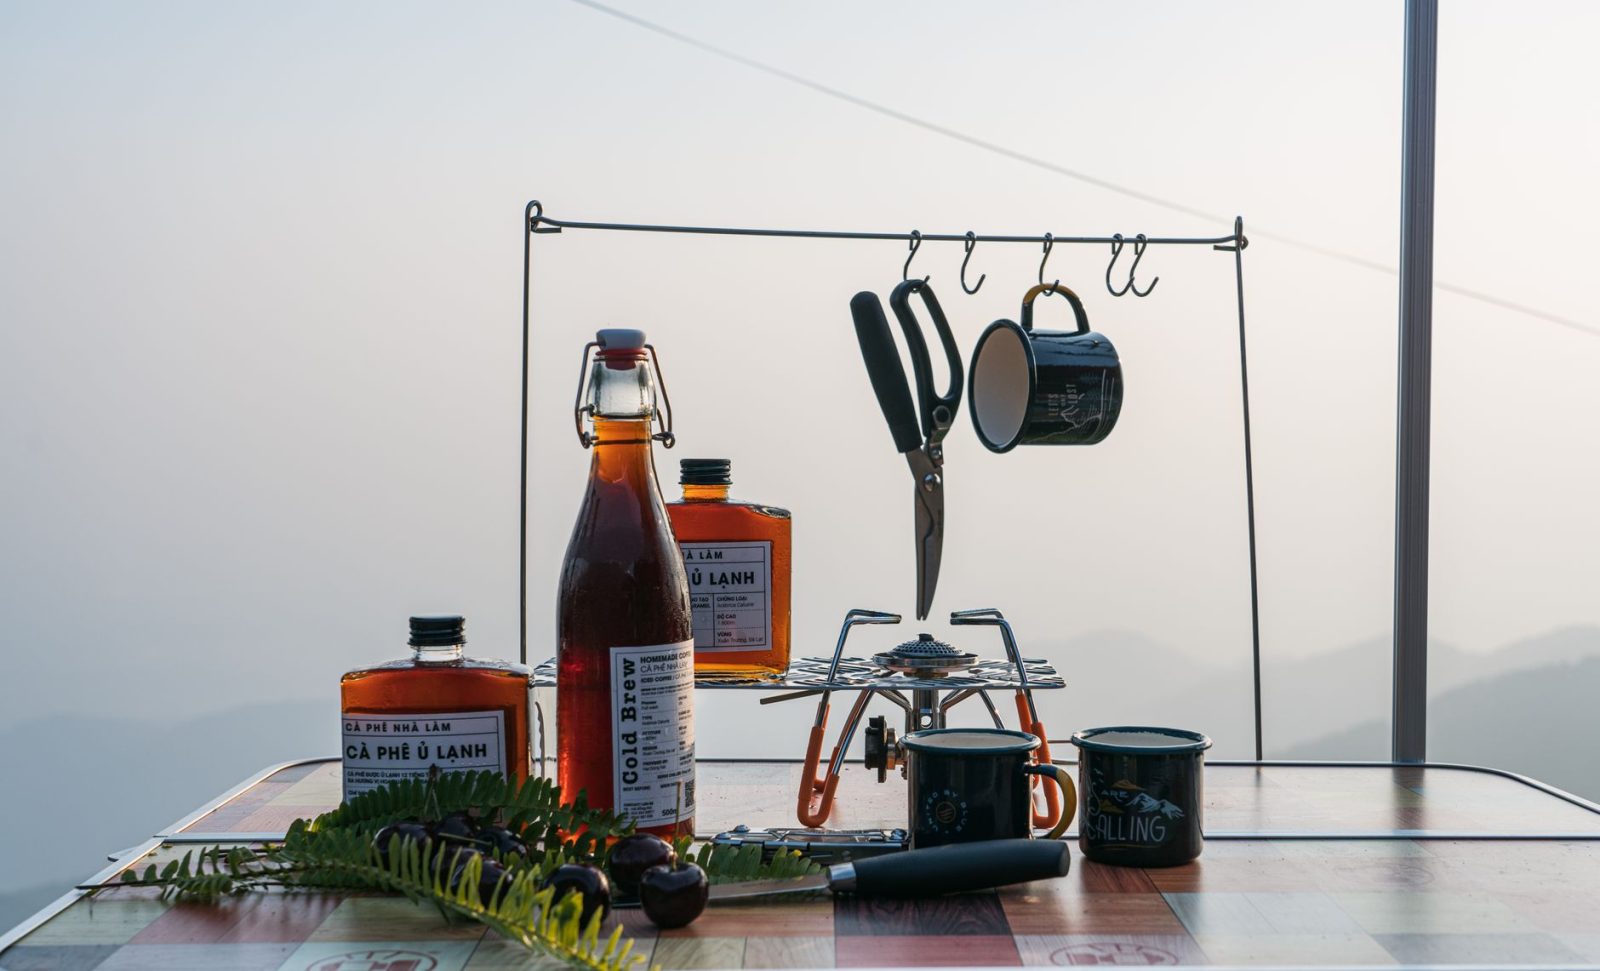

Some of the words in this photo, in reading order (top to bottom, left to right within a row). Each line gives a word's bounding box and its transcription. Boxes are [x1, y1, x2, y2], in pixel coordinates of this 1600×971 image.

[1066, 384, 1078, 404] LOST
[700, 550, 723, 560] LÀM
[691, 567, 702, 586] Ủ
[709, 571, 755, 589] LẠNH
[621, 657, 637, 723] Brew
[345, 722, 361, 733] CÀ
[366, 721, 388, 733] PHÊ
[393, 722, 419, 733] NHÀ
[425, 720, 451, 733] LÀM
[346, 742, 370, 760] CÀ
[377, 743, 410, 760] PHÊ
[418, 741, 429, 760] Ủ
[437, 743, 487, 763] LẠNH
[622, 731, 639, 785] Cold
